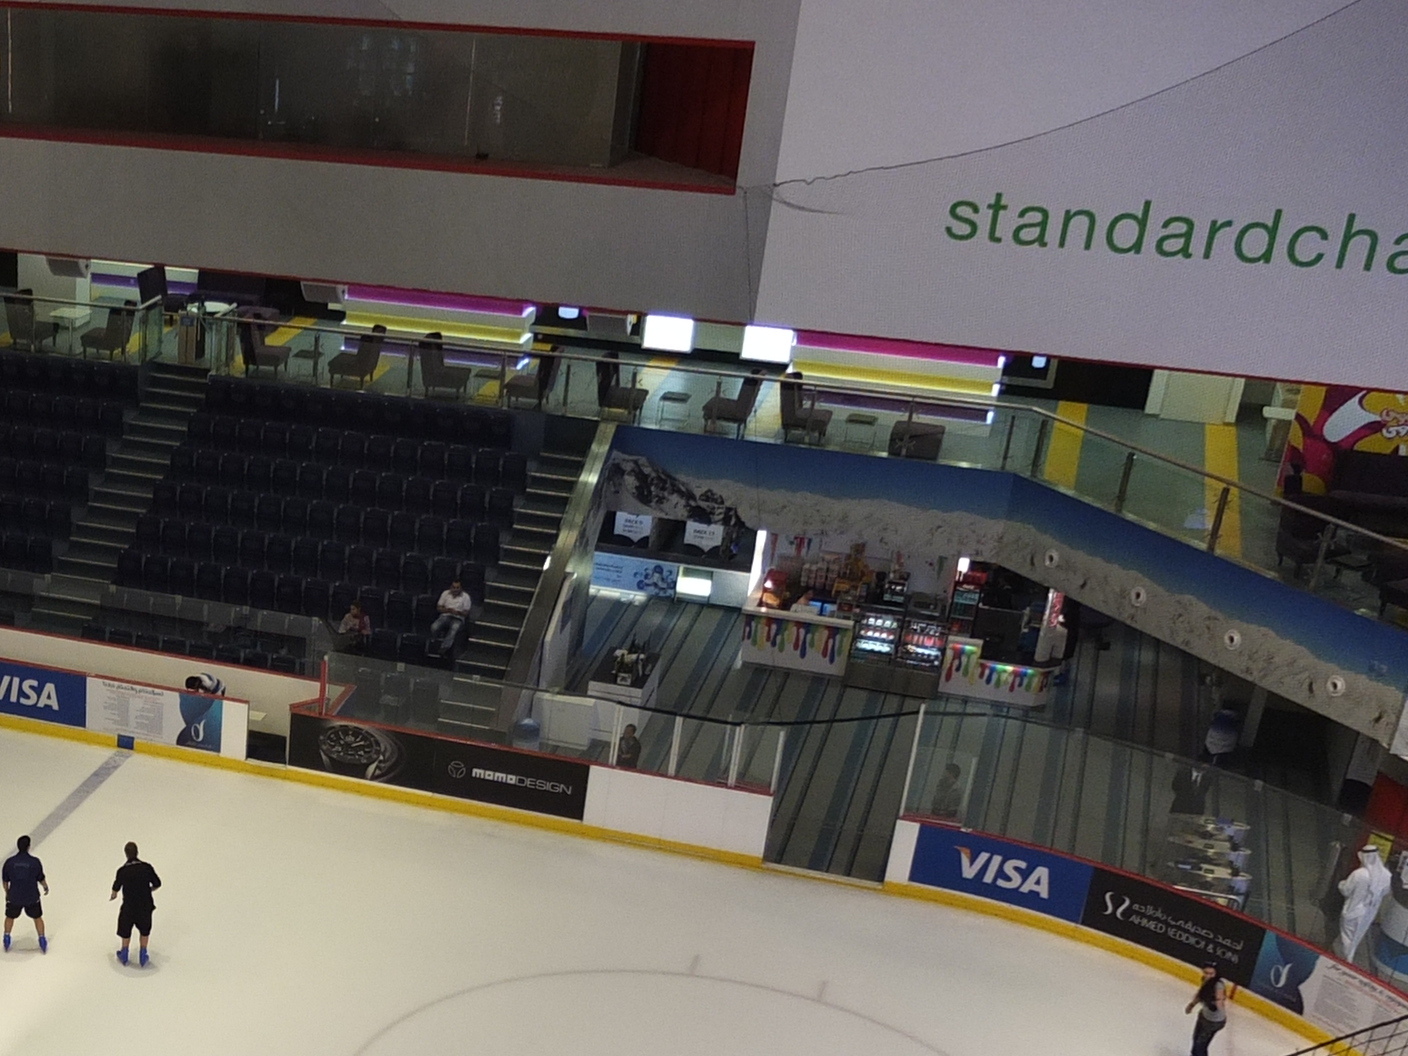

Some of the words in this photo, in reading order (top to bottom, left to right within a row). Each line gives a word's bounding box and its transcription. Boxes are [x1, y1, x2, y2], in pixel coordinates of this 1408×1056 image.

[954, 845, 1051, 900] VISA
[1129, 914, 1165, 934] AHMED
[1207, 943, 1215, 954] &
